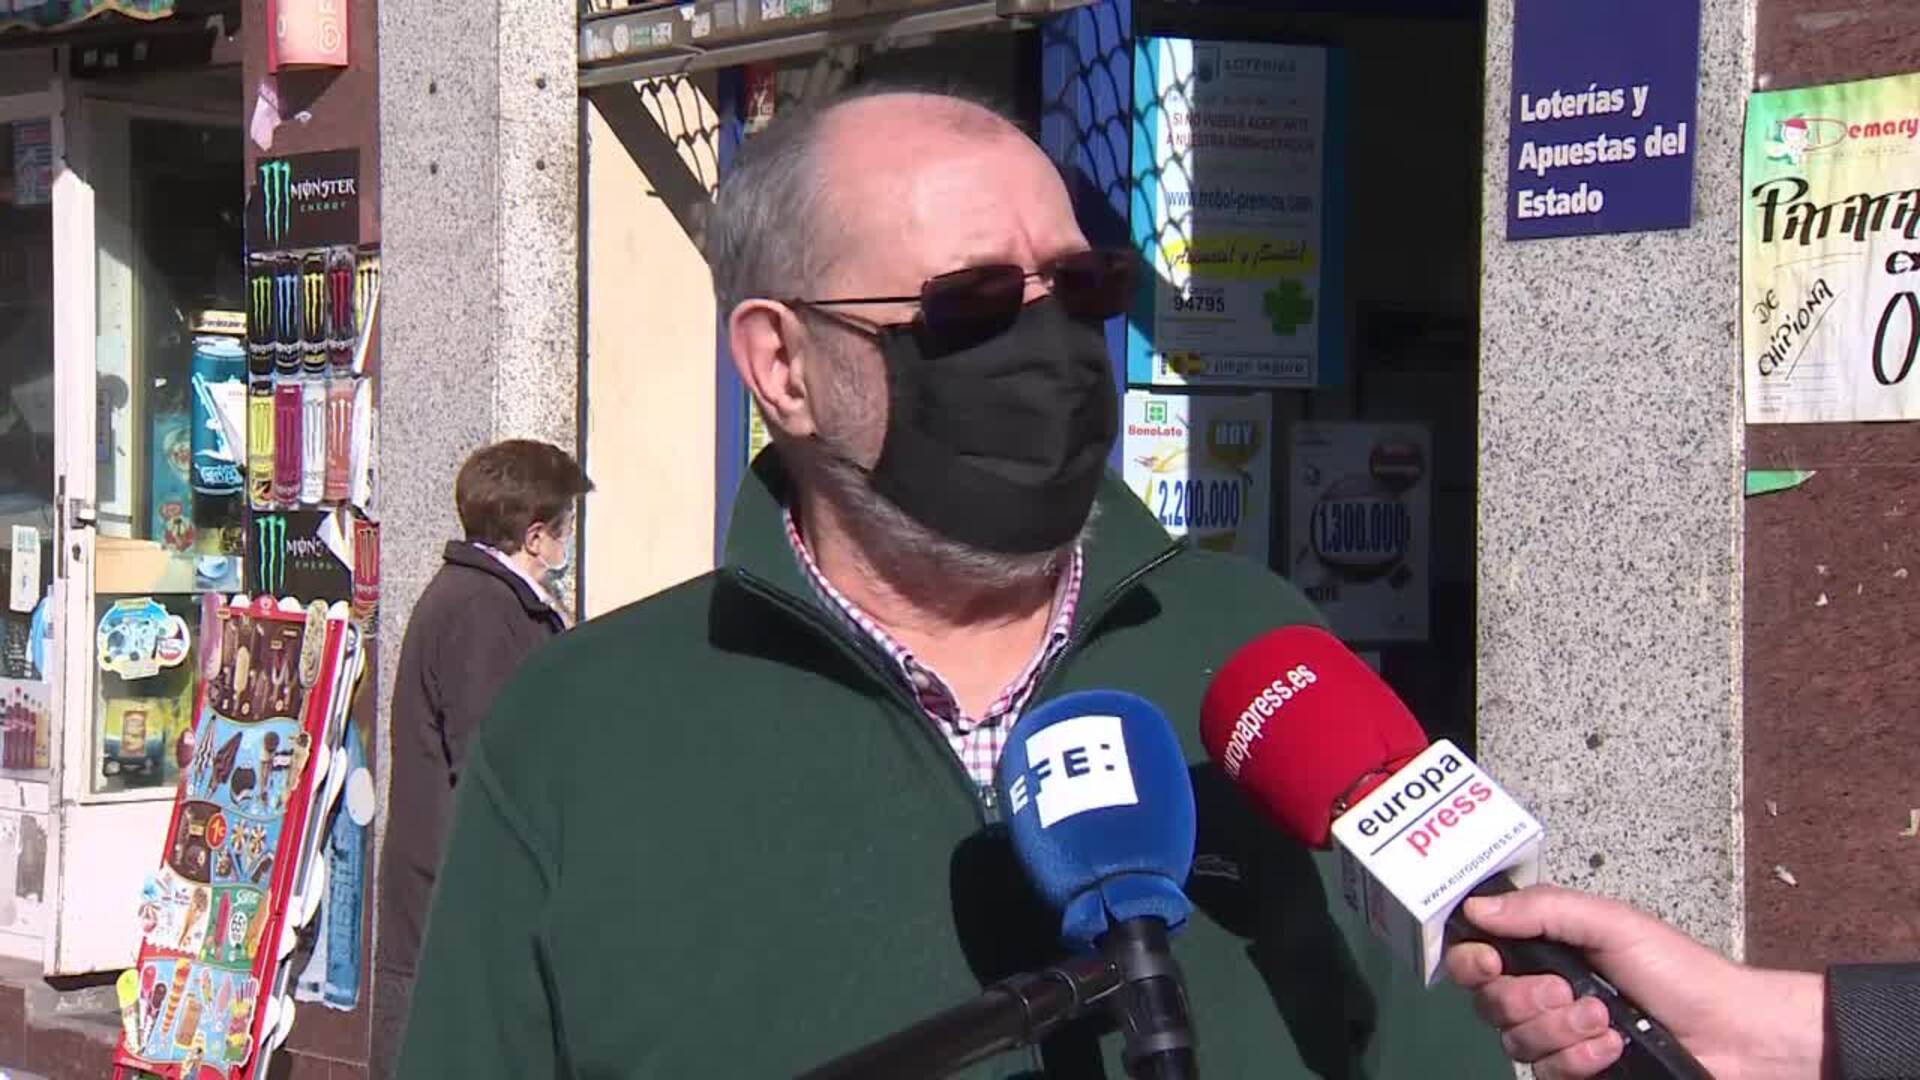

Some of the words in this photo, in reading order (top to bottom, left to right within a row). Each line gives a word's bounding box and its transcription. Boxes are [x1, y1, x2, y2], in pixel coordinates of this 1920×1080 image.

[1520, 83, 1625, 122] Loterías
[1631, 84, 1649, 118] y
[1517, 133, 1637, 177] Apuestas
[1644, 122, 1687, 157] del
[290, 178, 356, 201] MONSTER
[1517, 182, 1604, 219] Estado
[1173, 296, 1225, 313] 94795
[1158, 479, 1240, 527] 2.200.000
[286, 536, 323, 558] MONS
[1357, 753, 1462, 837] europa
[1405, 781, 1493, 858] press
[1422, 821, 1528, 907] www.europapress.es
